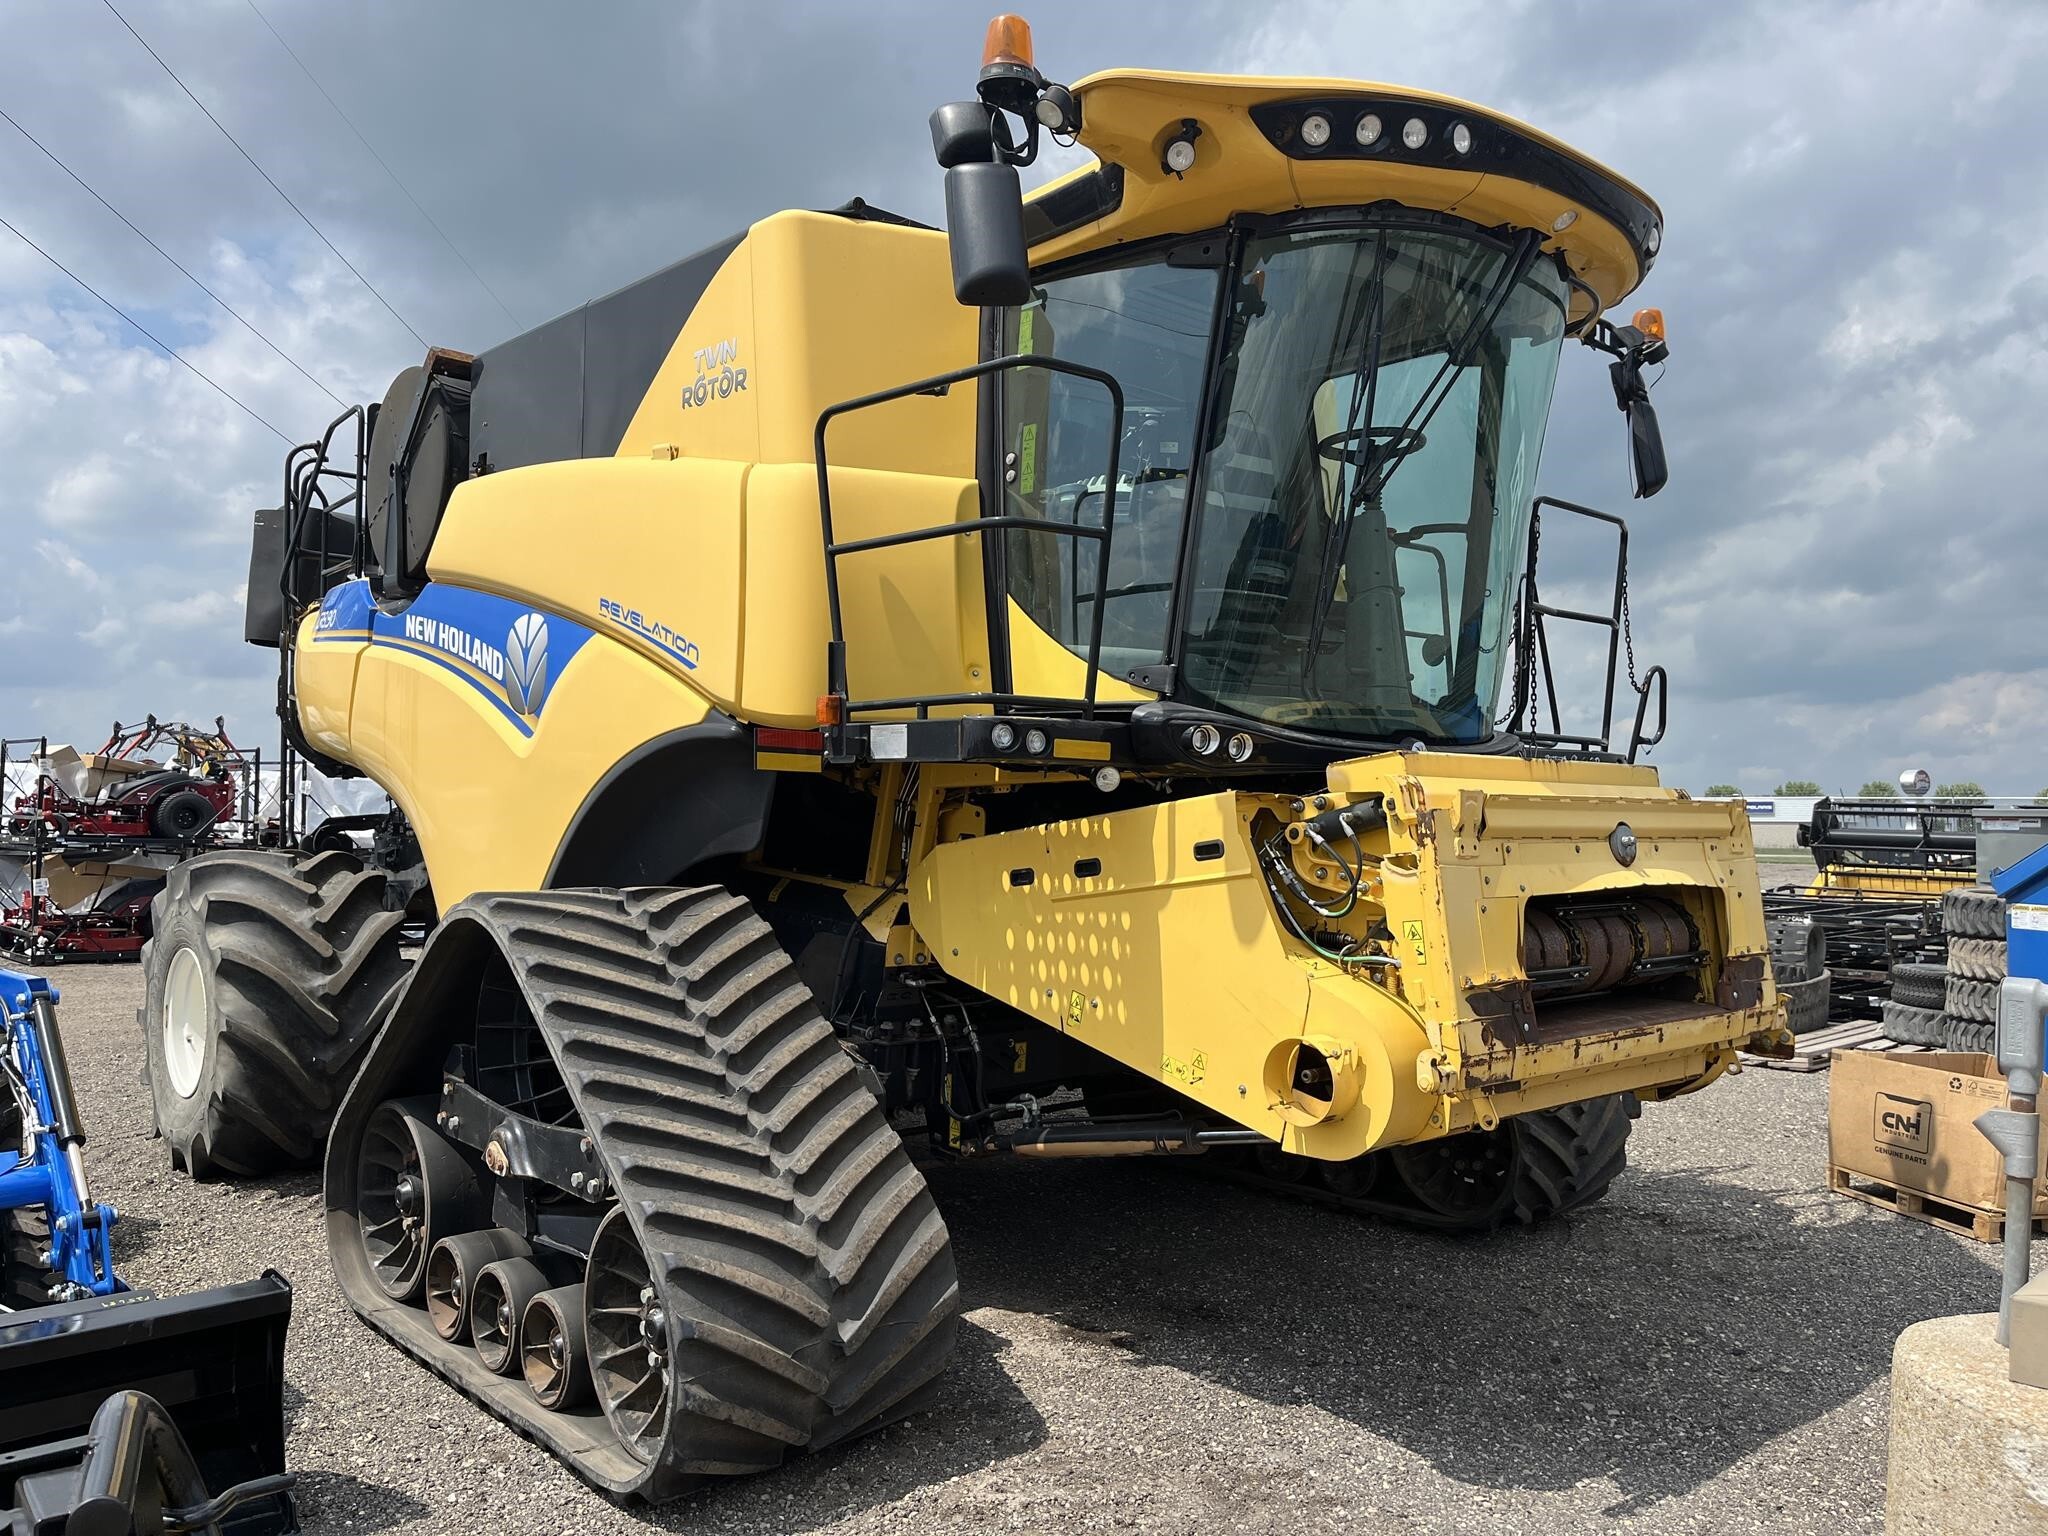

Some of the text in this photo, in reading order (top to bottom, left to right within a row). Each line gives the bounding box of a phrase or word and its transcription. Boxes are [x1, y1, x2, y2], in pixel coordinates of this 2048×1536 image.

[693, 337, 738, 373] TWIN
[682, 364, 747, 410] ROTOR
[405, 613, 504, 681] NEW HOLLAND
[599, 598, 699, 663] REVELATION
[1881, 1128, 1920, 1141] INDUSTRIAL
[1874, 1145, 1927, 1166] GENUINE PARTS
